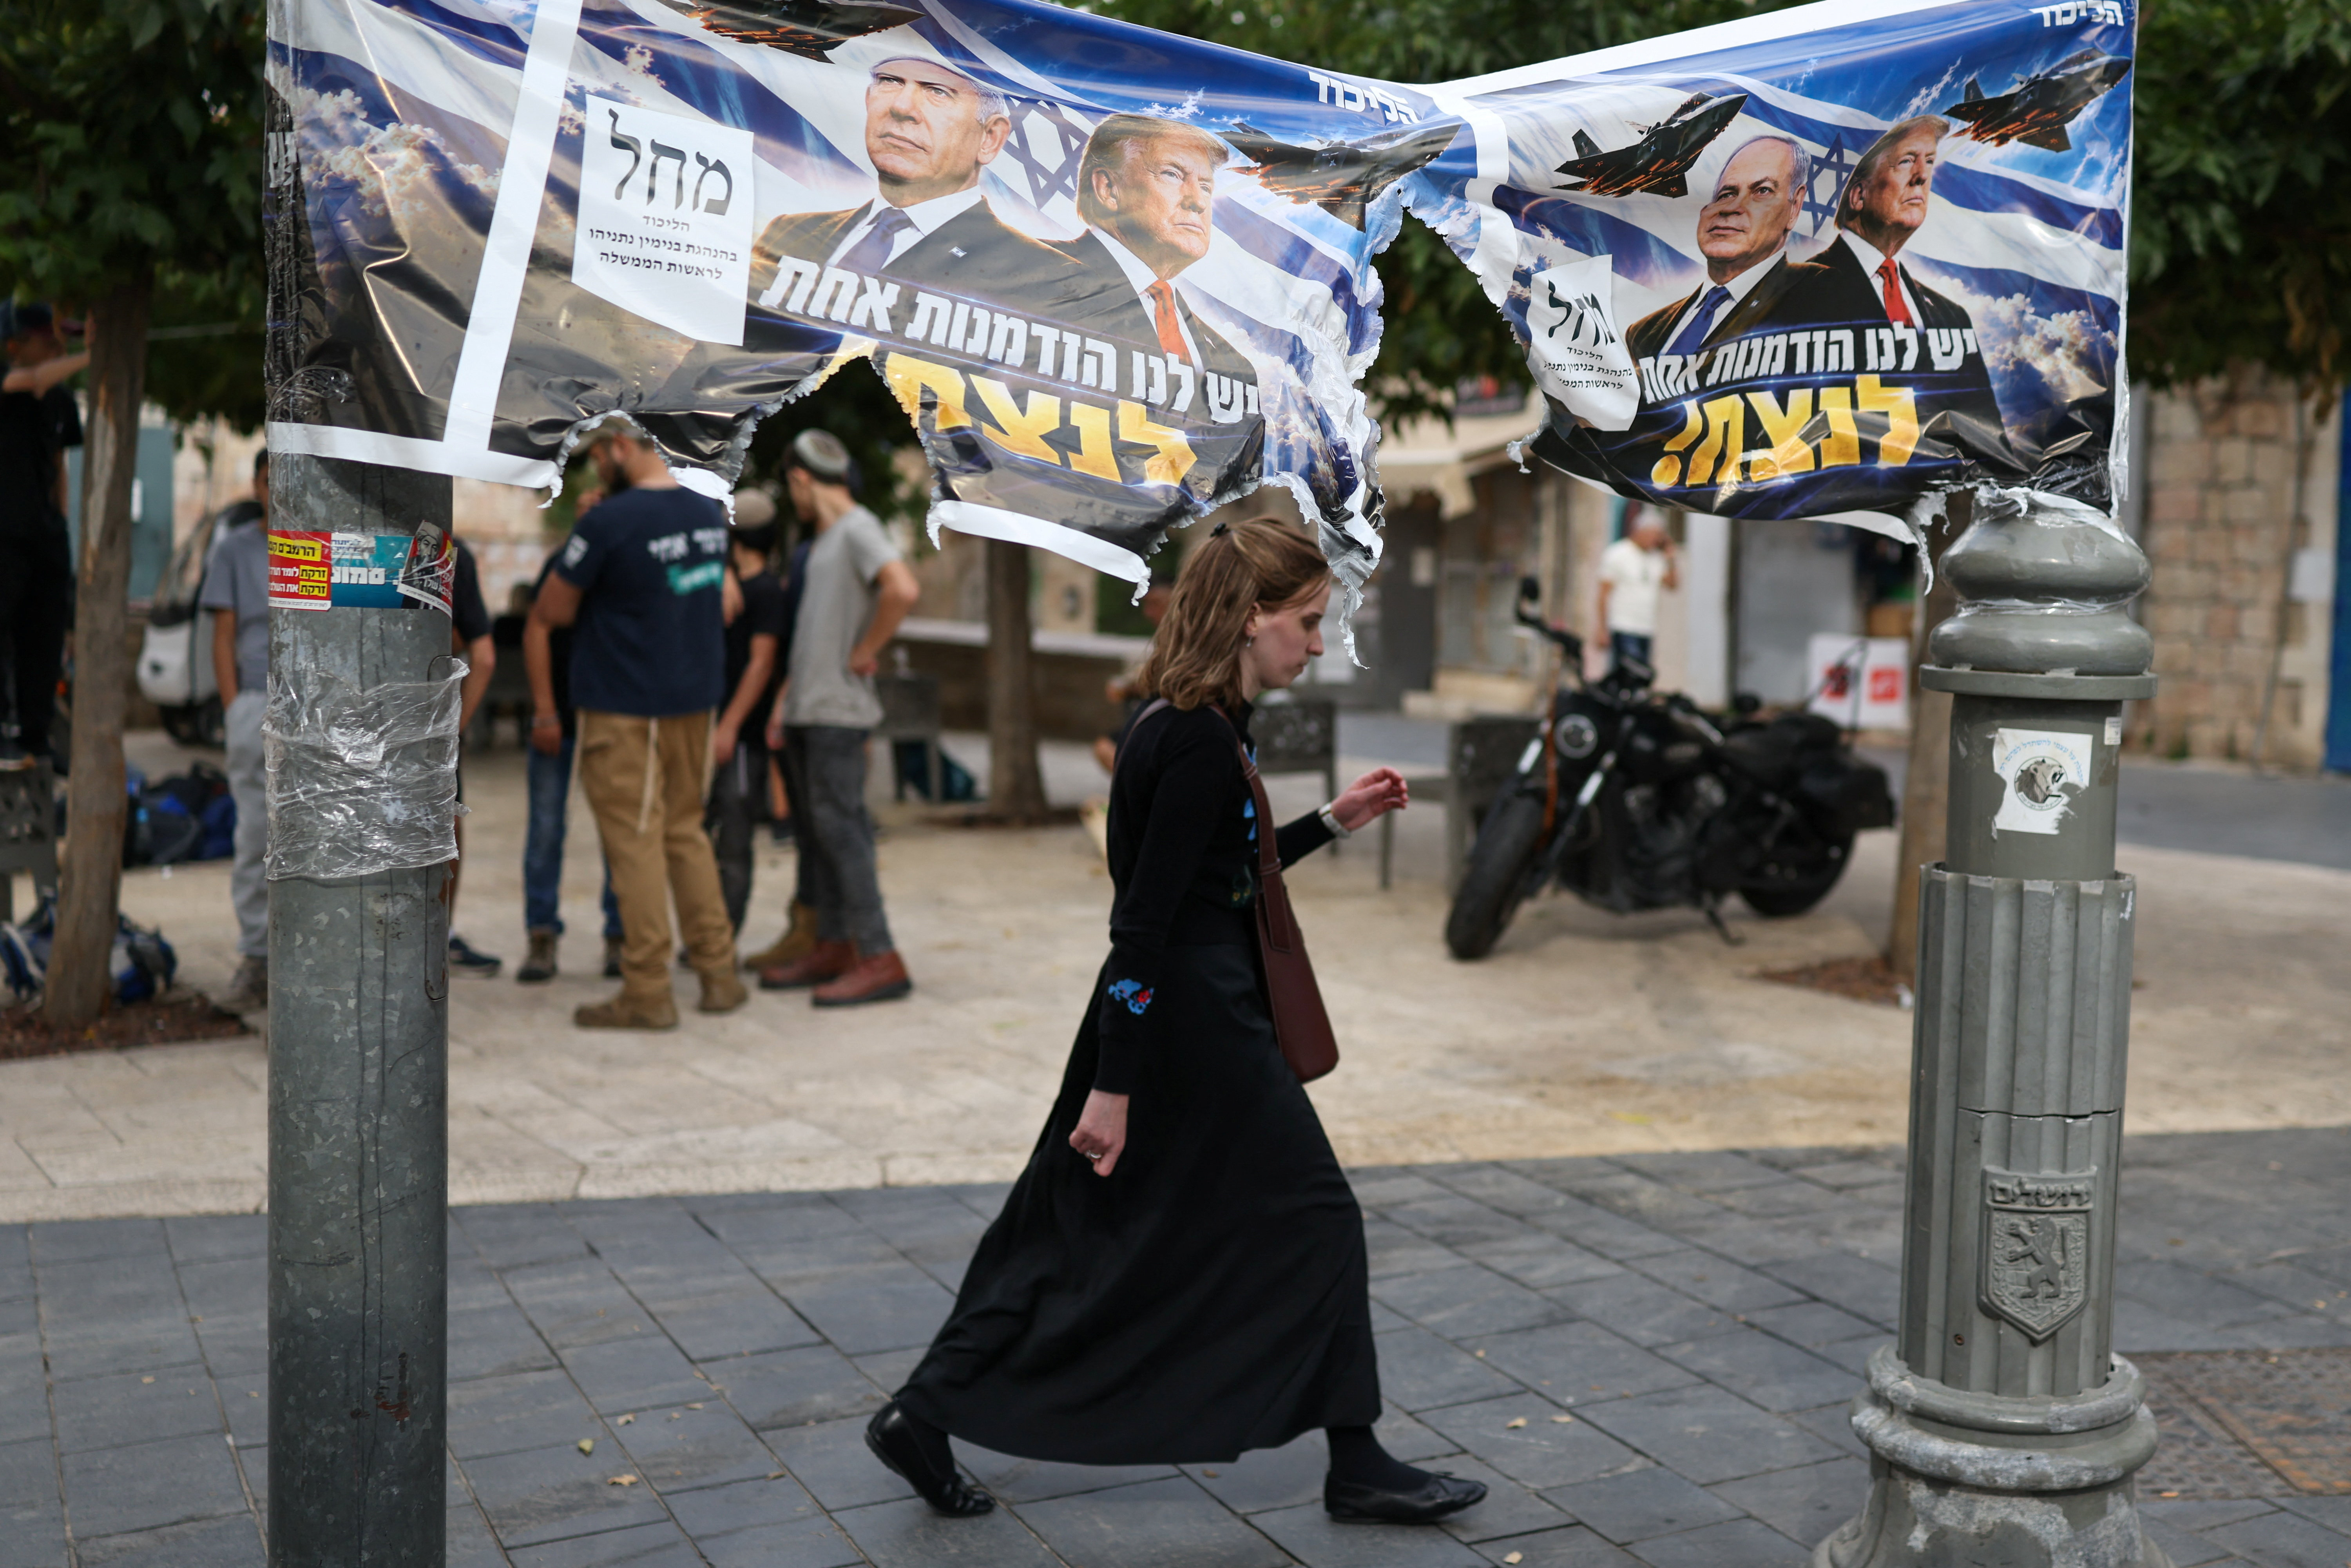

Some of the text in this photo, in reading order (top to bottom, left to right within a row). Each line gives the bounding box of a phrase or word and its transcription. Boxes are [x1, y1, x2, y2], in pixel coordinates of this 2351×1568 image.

[2029, 0, 2125, 27] הליכוד
[1308, 71, 1422, 125] הליכוד
[608, 108, 732, 216] מחל
[643, 215, 690, 232] הליכוד
[589, 228, 737, 262] בהנהגת בנימין נתניהו
[600, 251, 723, 279] לראשות הממשלה
[1548, 279, 1616, 348] מחל
[759, 255, 1259, 423] יש לנו הזדמנות אחת
[1567, 346, 1603, 361] הליכוד
[1639, 320, 1978, 405] יש לנו הזדמנות אחת
[1567, 363, 1594, 374] בנימין
[1586, 380, 1624, 389] לראשות
[1651, 374, 1920, 491] לנצח!
[301, 569, 326, 579] זרקת
[301, 585, 326, 596] זרקת
